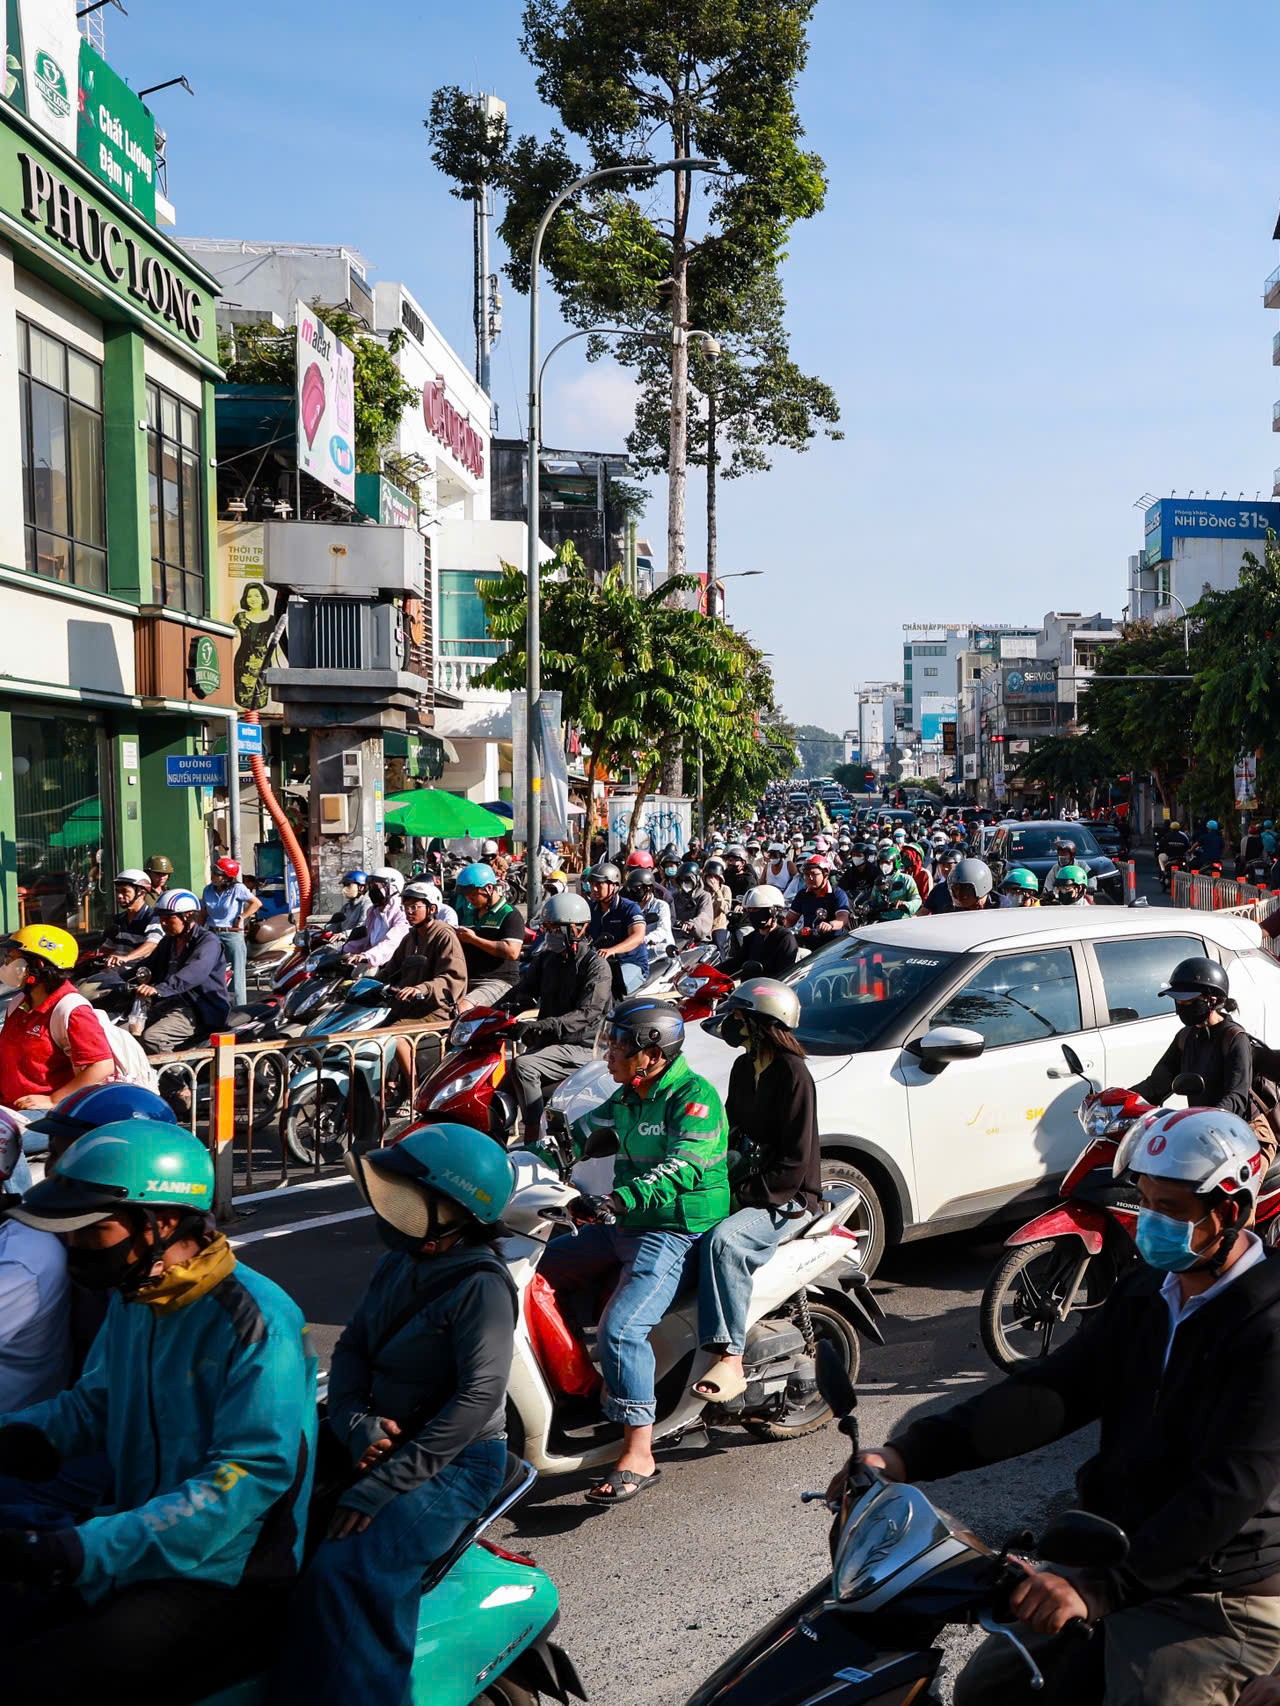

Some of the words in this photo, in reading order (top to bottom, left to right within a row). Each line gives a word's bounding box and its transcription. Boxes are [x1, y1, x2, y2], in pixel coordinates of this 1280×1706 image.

[99, 104, 123, 150] Chất
[125, 130, 152, 183] Lượng
[99, 142, 122, 187] Đậm
[124, 170, 133, 202] vị
[17, 153, 125, 284] PHUC
[125, 238, 204, 343] LONG
[301, 317, 331, 362] macat
[1174, 516, 1196, 526] NHI
[1199, 513, 1236, 528] ĐỒNG
[228, 554, 260, 563] TRUNG
[178, 759, 212, 768] ĐƯỜNG
[145, 1180, 191, 1194] XANH
[441, 1170, 478, 1195] XANH
[1116, 1201, 1140, 1210] HOND
